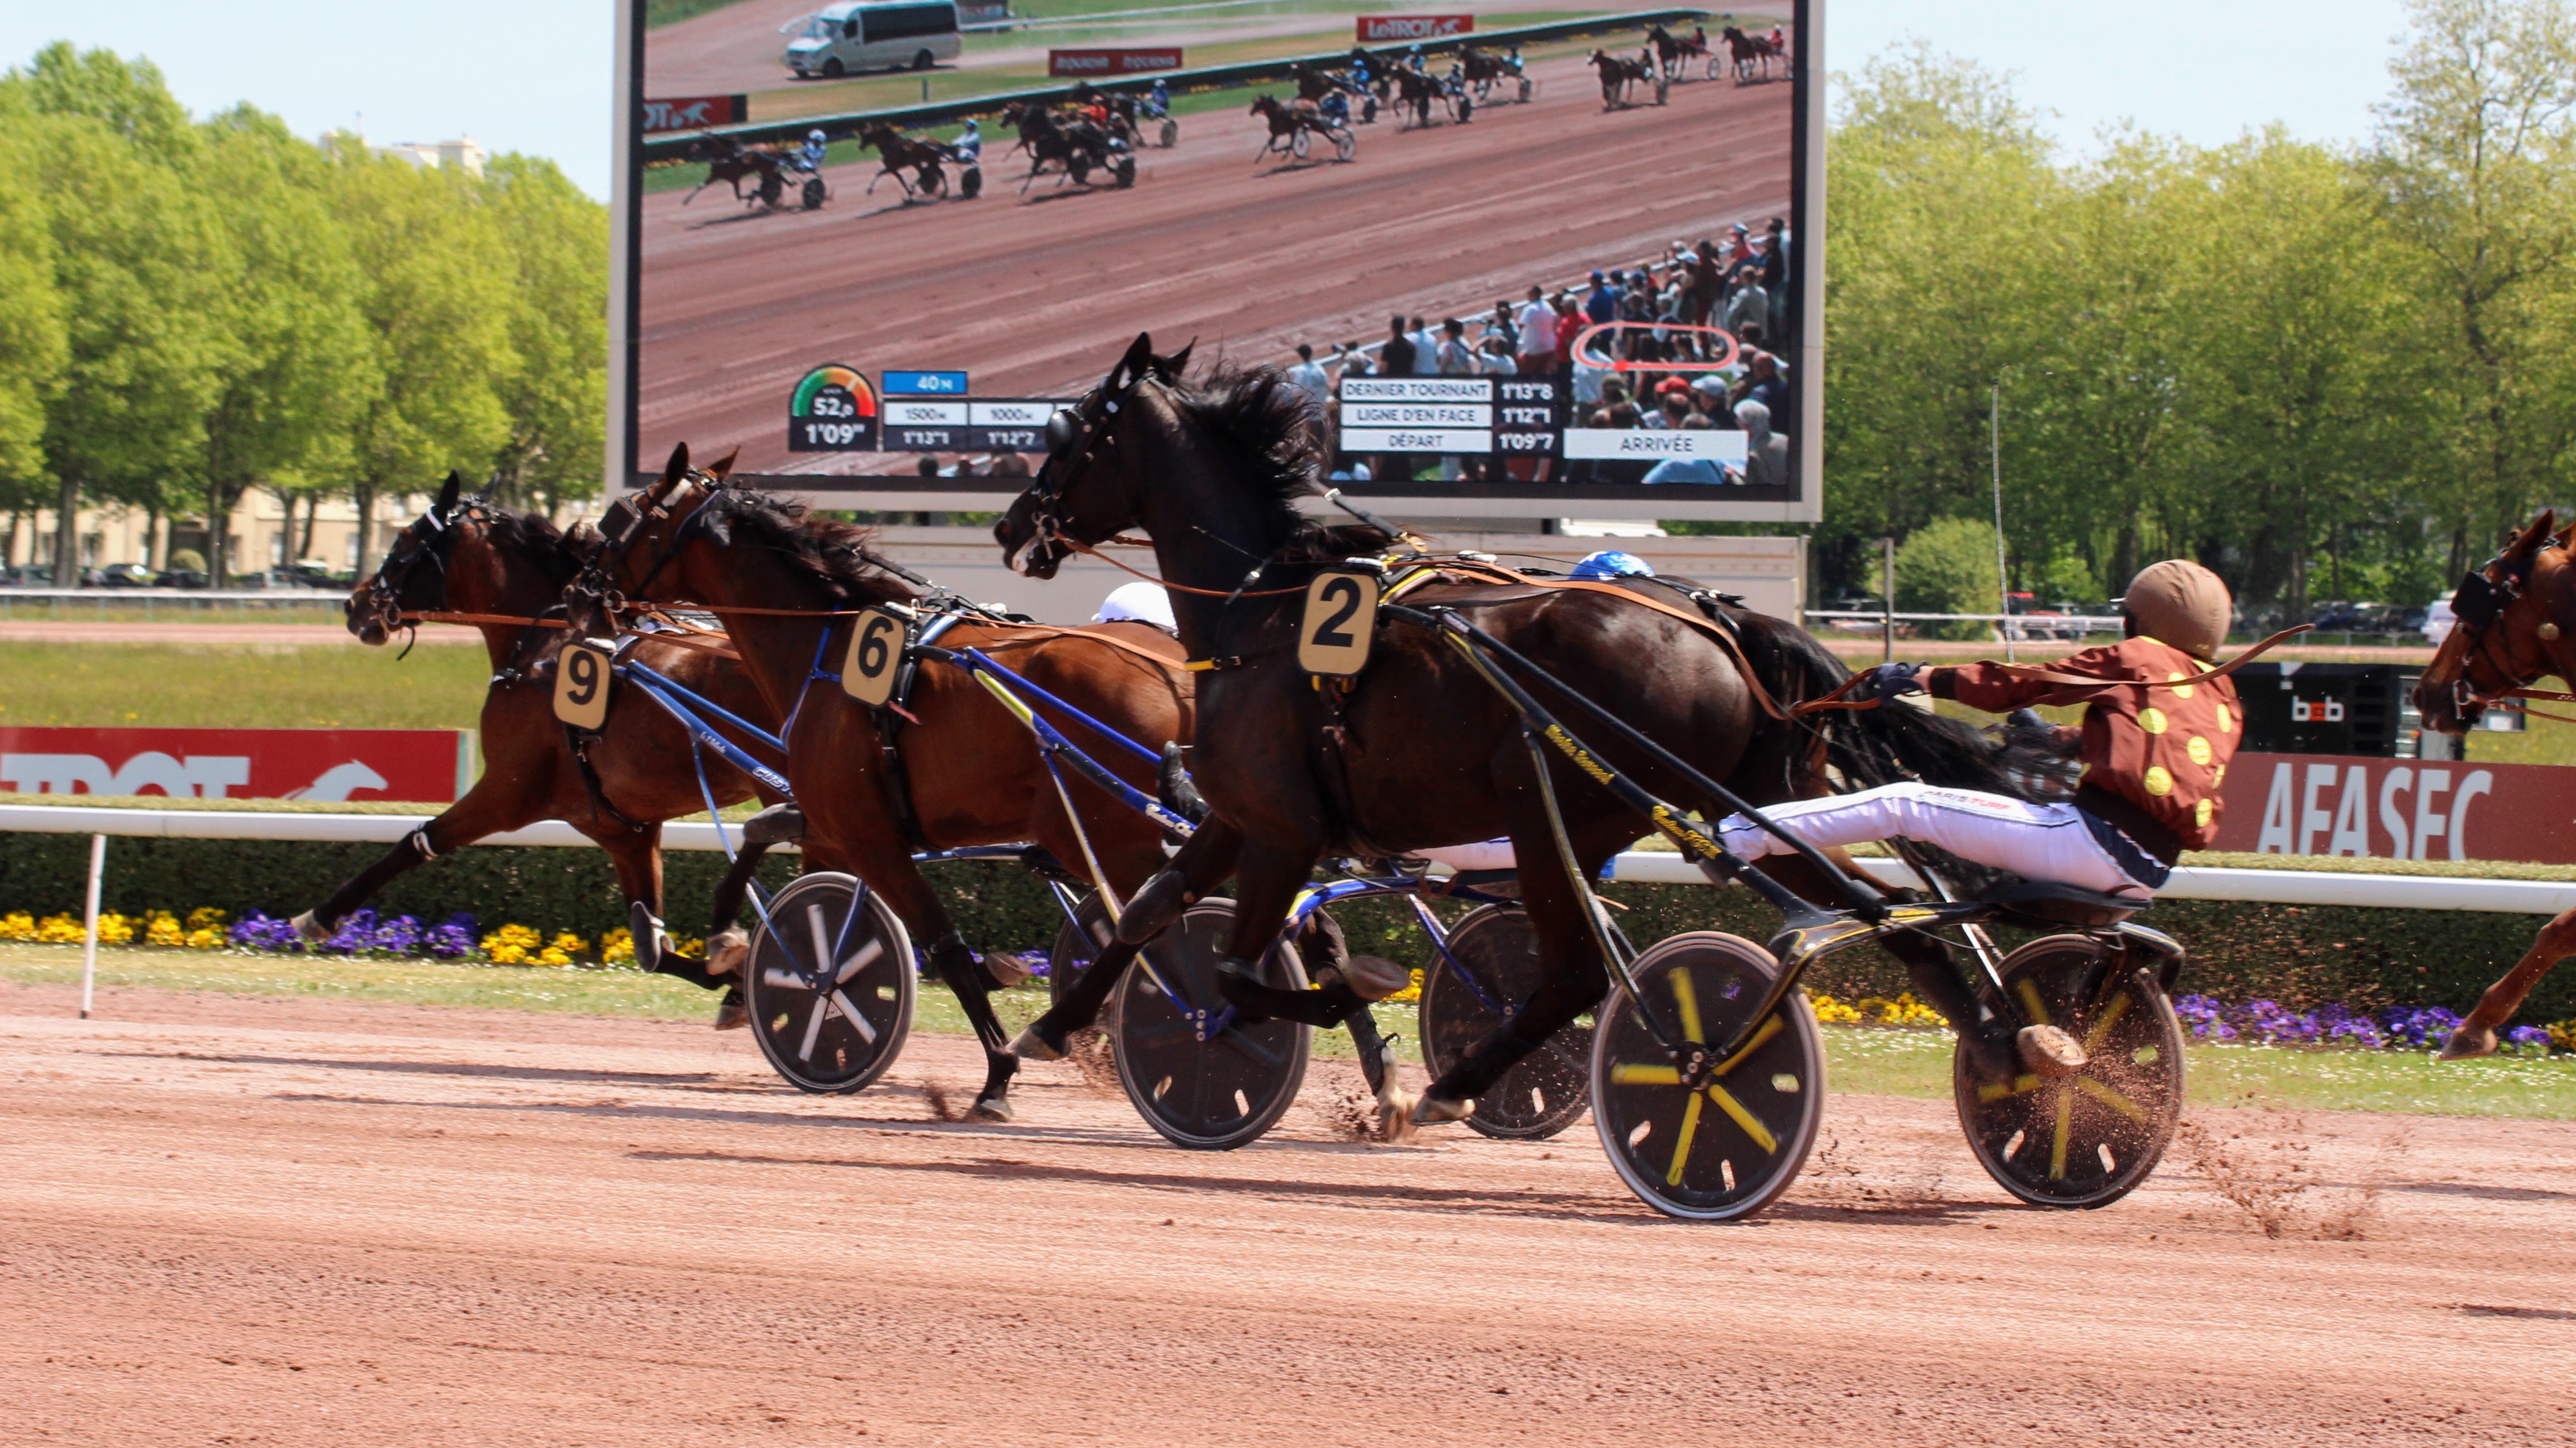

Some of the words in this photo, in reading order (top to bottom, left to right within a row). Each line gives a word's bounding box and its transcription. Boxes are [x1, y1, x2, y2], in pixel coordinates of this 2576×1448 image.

[1346, 383, 1405, 395] DERNIER
[1409, 383, 1488, 396] TOURNANT
[1356, 409, 1399, 421] LIGNE
[1403, 409, 1434, 421] D'EN
[1439, 409, 1475, 422] FACE
[1388, 431, 1444, 447] DÉPART
[1620, 433, 1693, 452] ARRIVÉE
[1311, 577, 1361, 648] 2
[858, 616, 894, 678] 6
[567, 649, 598, 706] 9
